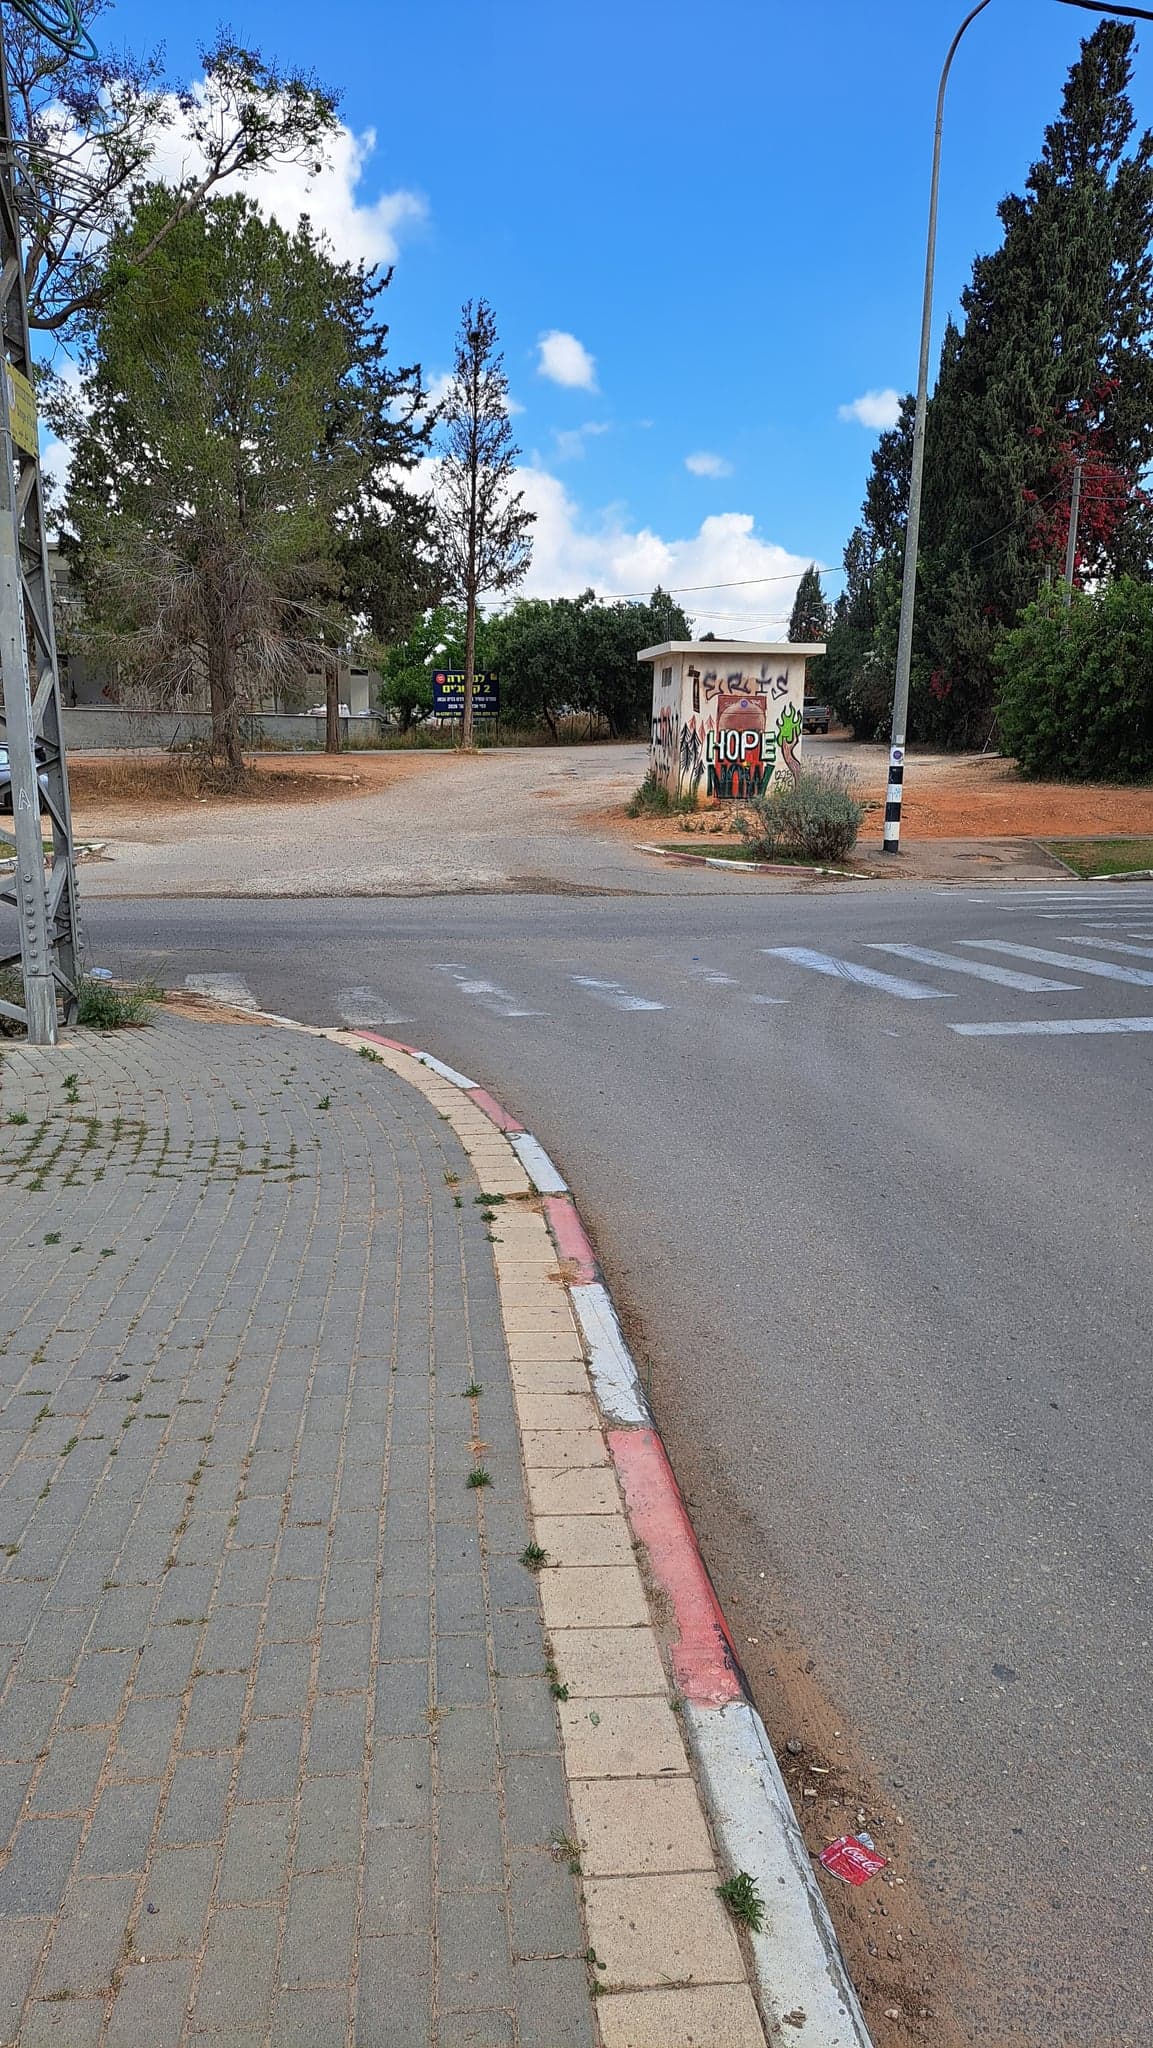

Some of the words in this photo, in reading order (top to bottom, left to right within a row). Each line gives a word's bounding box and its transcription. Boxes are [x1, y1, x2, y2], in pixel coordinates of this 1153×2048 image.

[447, 674, 485, 683] למירה
[483, 684, 491, 693] 2
[706, 730, 776, 762] HOPE
[706, 764, 775, 798] NOW
